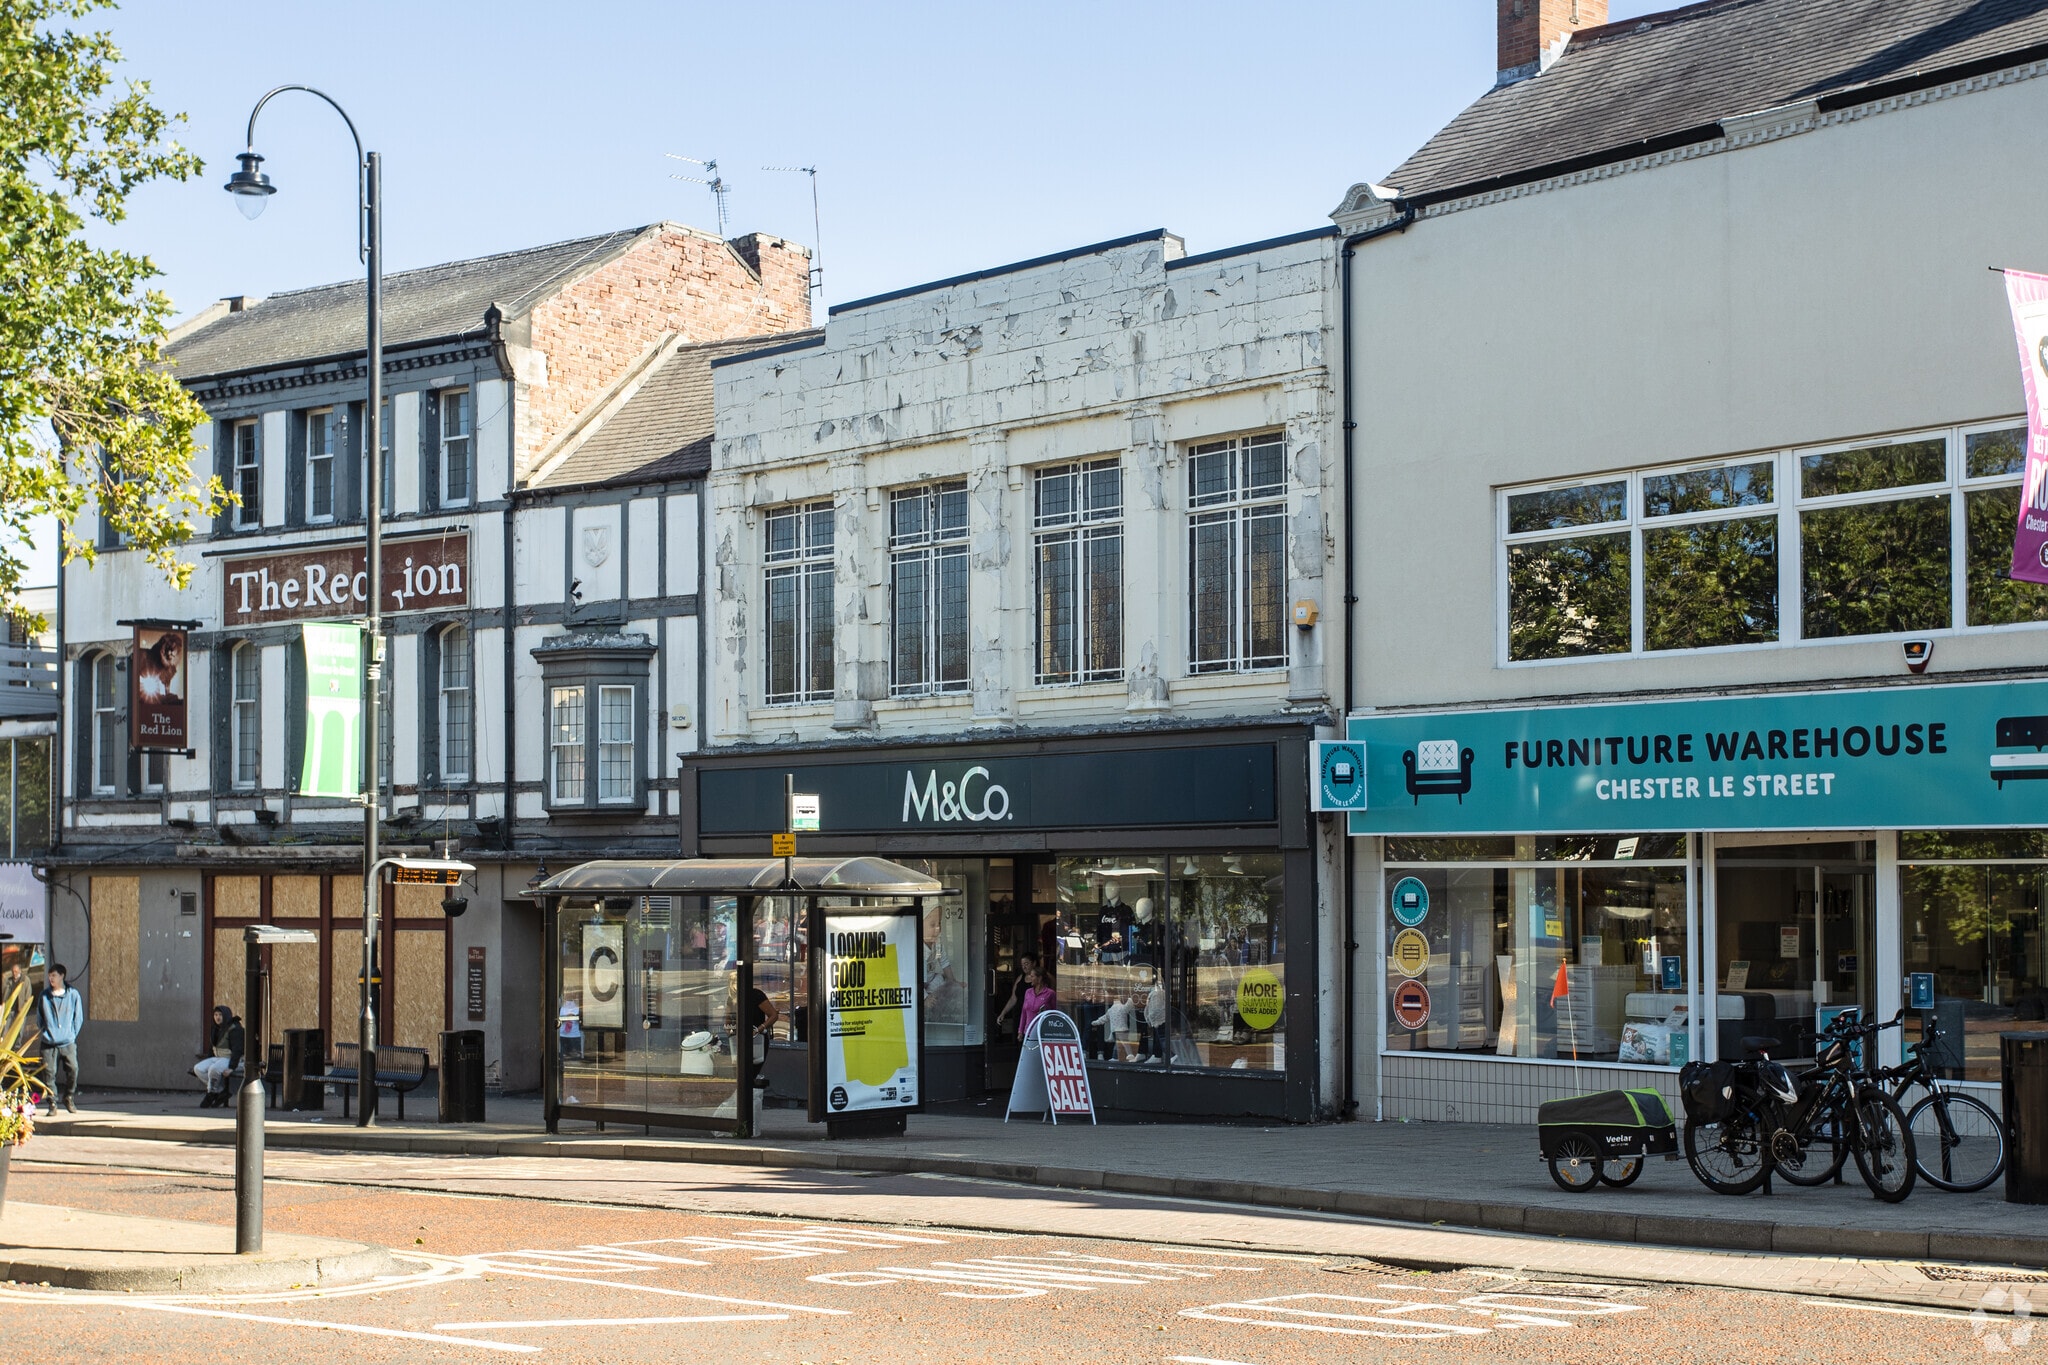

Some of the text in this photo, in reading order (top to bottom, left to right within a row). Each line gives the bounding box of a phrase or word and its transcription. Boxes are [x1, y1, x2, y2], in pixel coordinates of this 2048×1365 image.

[230, 567, 300, 614] The
[392, 557, 463, 609] ion
[141, 724, 182, 736] Red Lion
[152, 713, 171, 724] The
[1504, 722, 1948, 769] FURNITURE WAREHOUSE
[1322, 745, 1364, 779] FURNITURE WAREHOUSE
[902, 766, 1013, 822] M&Co.
[1324, 784, 1342, 806] CHESTER
[1349, 784, 1363, 805] STREET
[1596, 772, 1834, 800] CHESTER LE STREET
[945, 908, 950, 919] 3
[830, 931, 886, 959] LOOKING
[588, 946, 618, 1002] C
[830, 961, 866, 988] GOOD
[830, 987, 912, 1007] CHESTER-LE-STREET!
[1243, 983, 1277, 998] MORE
[1243, 997, 1277, 1008] SUMMER
[1044, 1045, 1082, 1076] SALE
[1050, 1080, 1089, 1110] SALE
